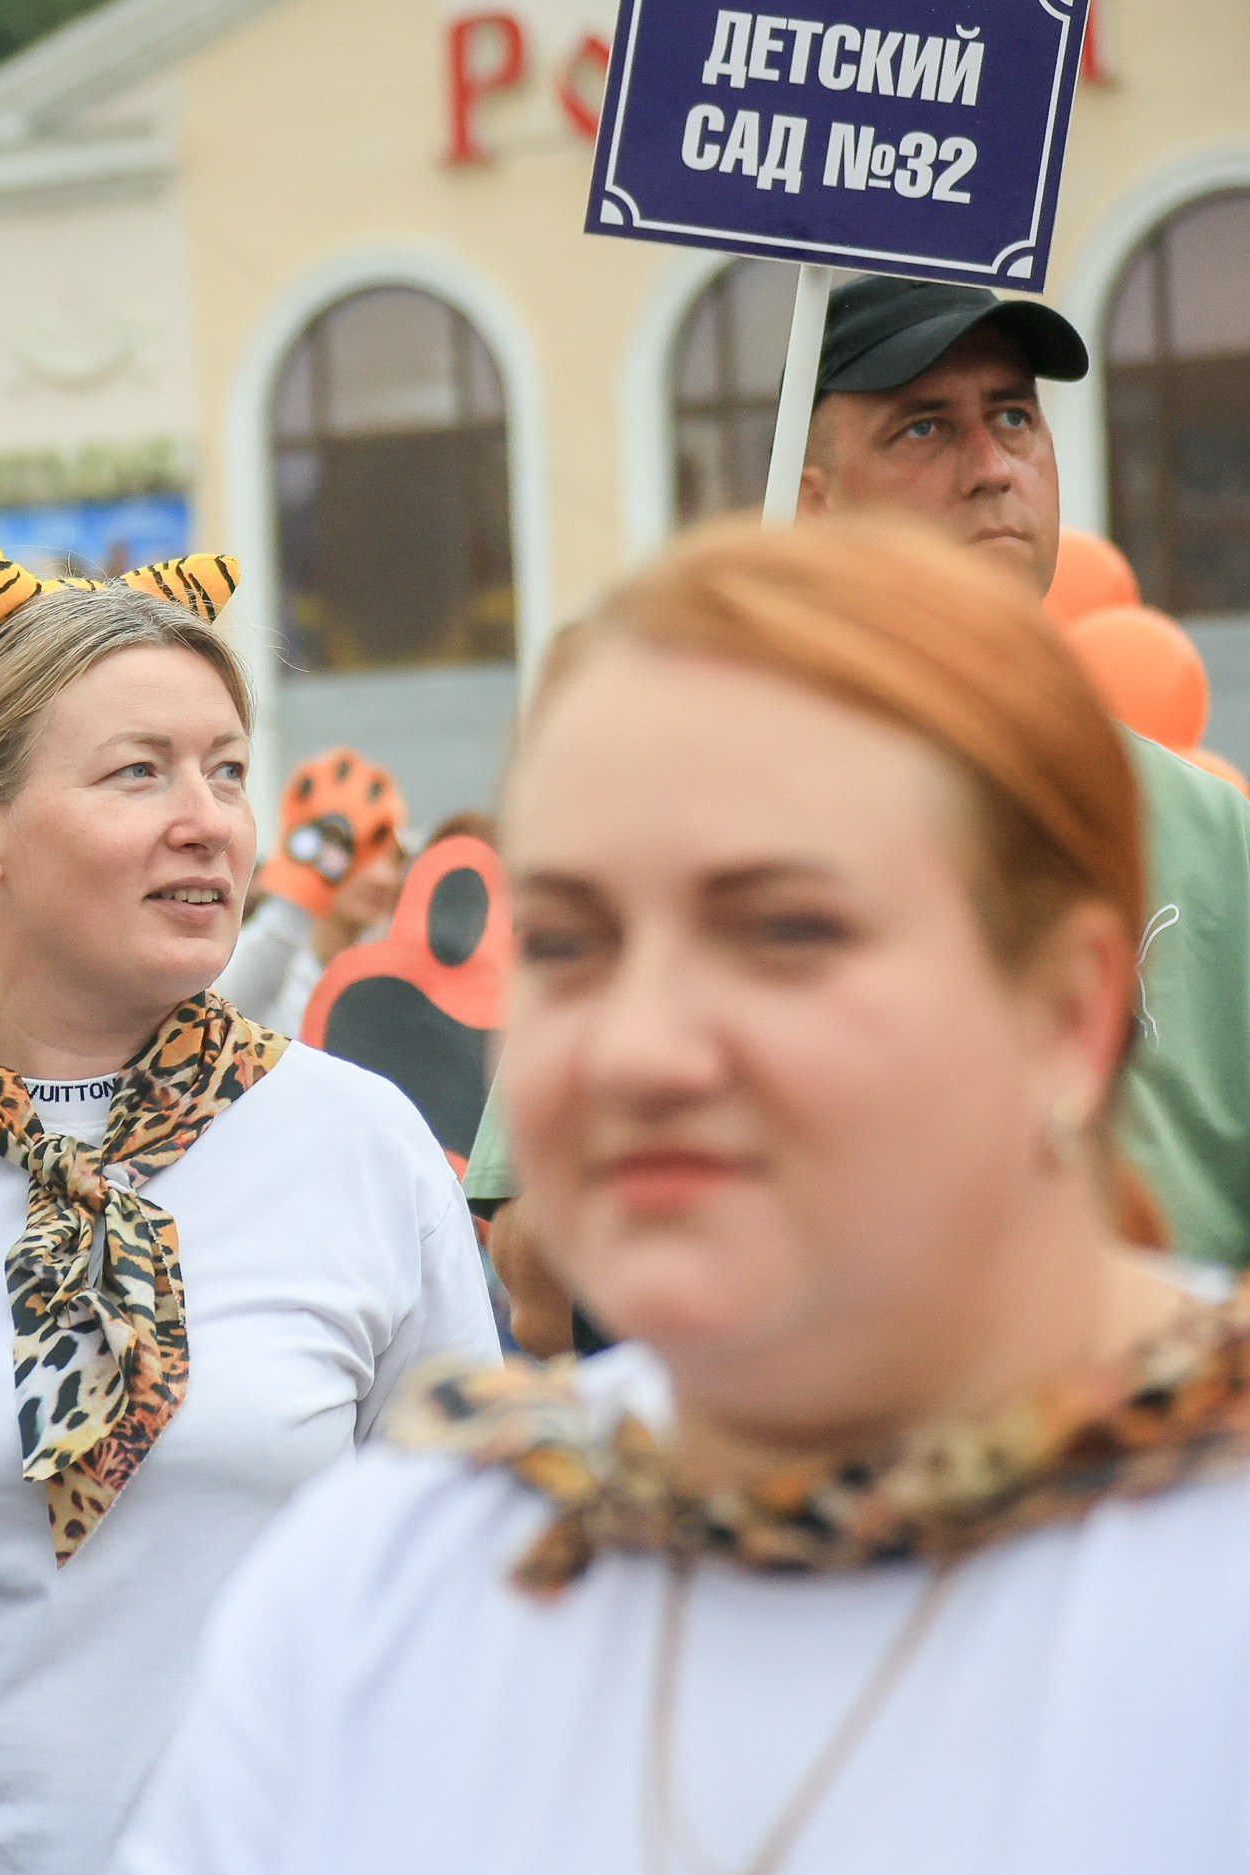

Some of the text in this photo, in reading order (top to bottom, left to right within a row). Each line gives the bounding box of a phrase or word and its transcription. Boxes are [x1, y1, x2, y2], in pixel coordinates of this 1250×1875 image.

[702, 10, 984, 106] ДЕТСКИЙ
[681, 103, 978, 204] САД №32
